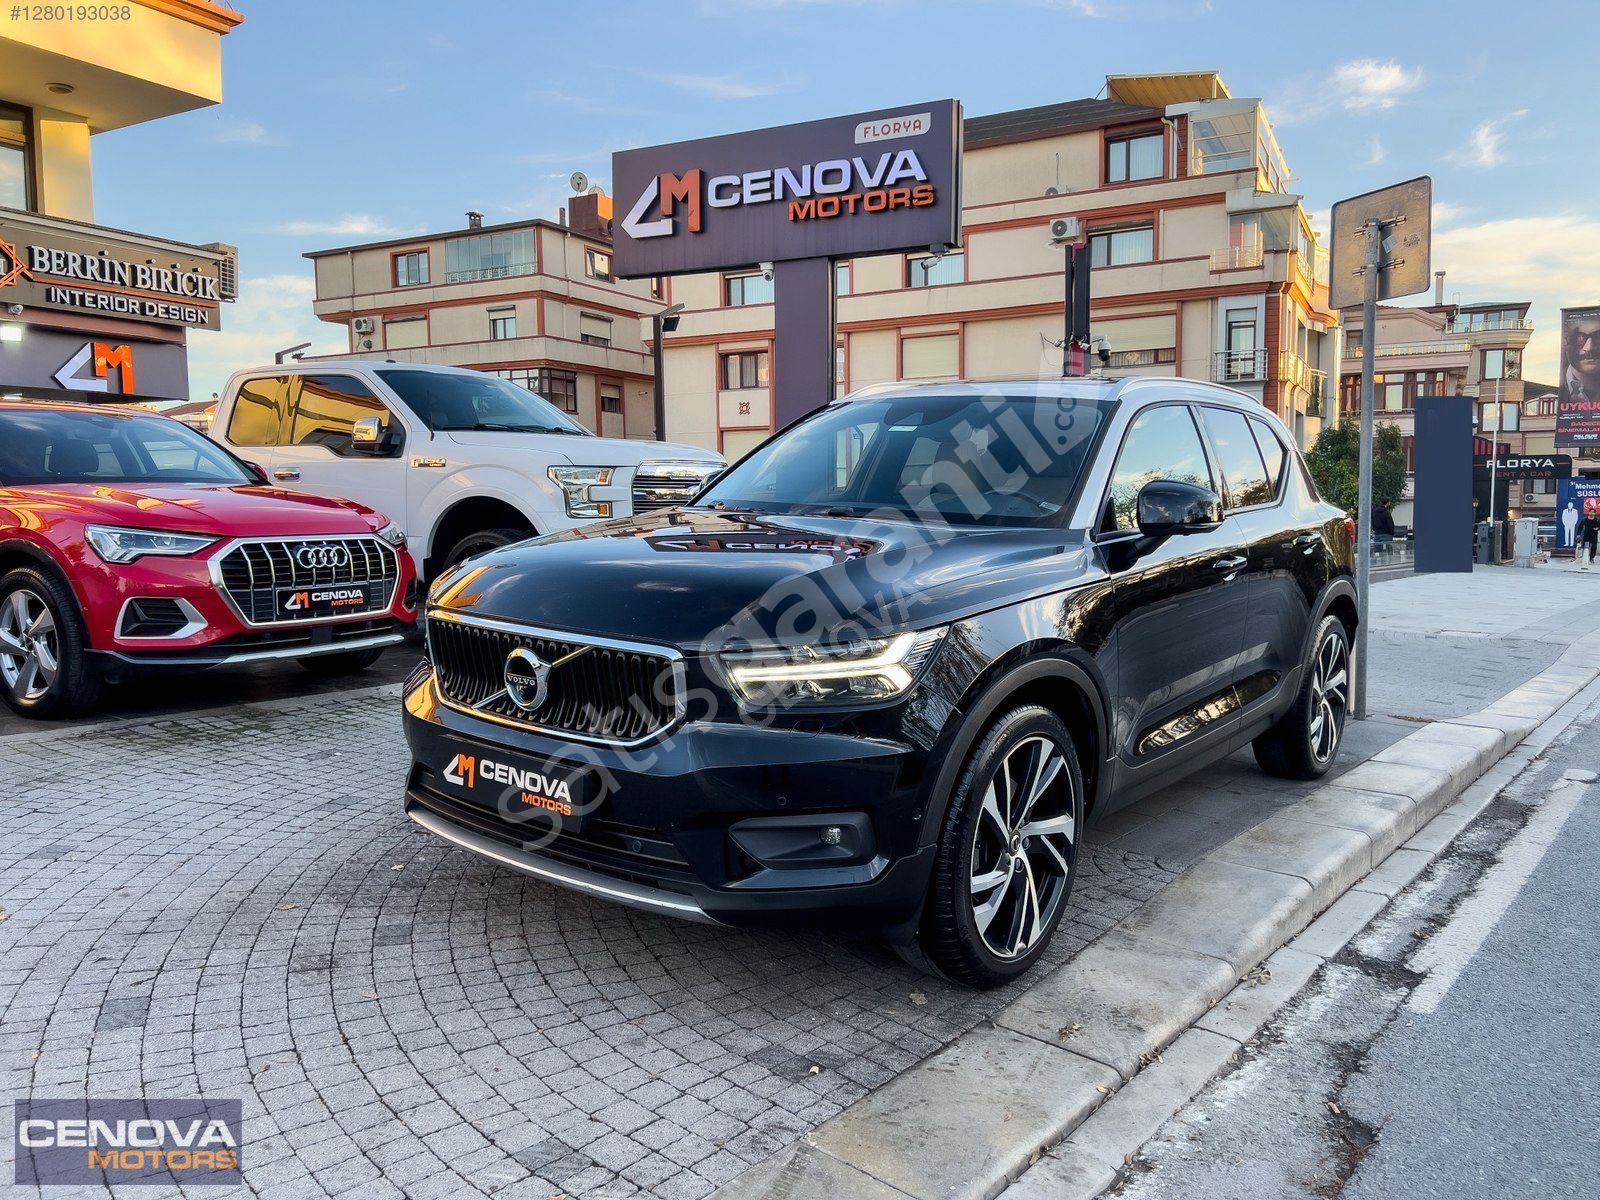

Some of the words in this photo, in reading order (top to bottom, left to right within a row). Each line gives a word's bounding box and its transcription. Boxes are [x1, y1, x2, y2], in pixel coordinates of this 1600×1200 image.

[863, 119, 922, 139] FLORYA
[708, 149, 928, 208] CENOVA
[788, 184, 934, 222] MOTORS
[50, 287, 141, 314] INTERIOR
[145, 302, 209, 324] DESIGN
[311, 589, 364, 602] CENOVA
[330, 598, 364, 607] MOTORS
[506, 674, 536, 686] VOLVO
[479, 760, 572, 803] CENOVA
[521, 791, 572, 816] MOTORS
